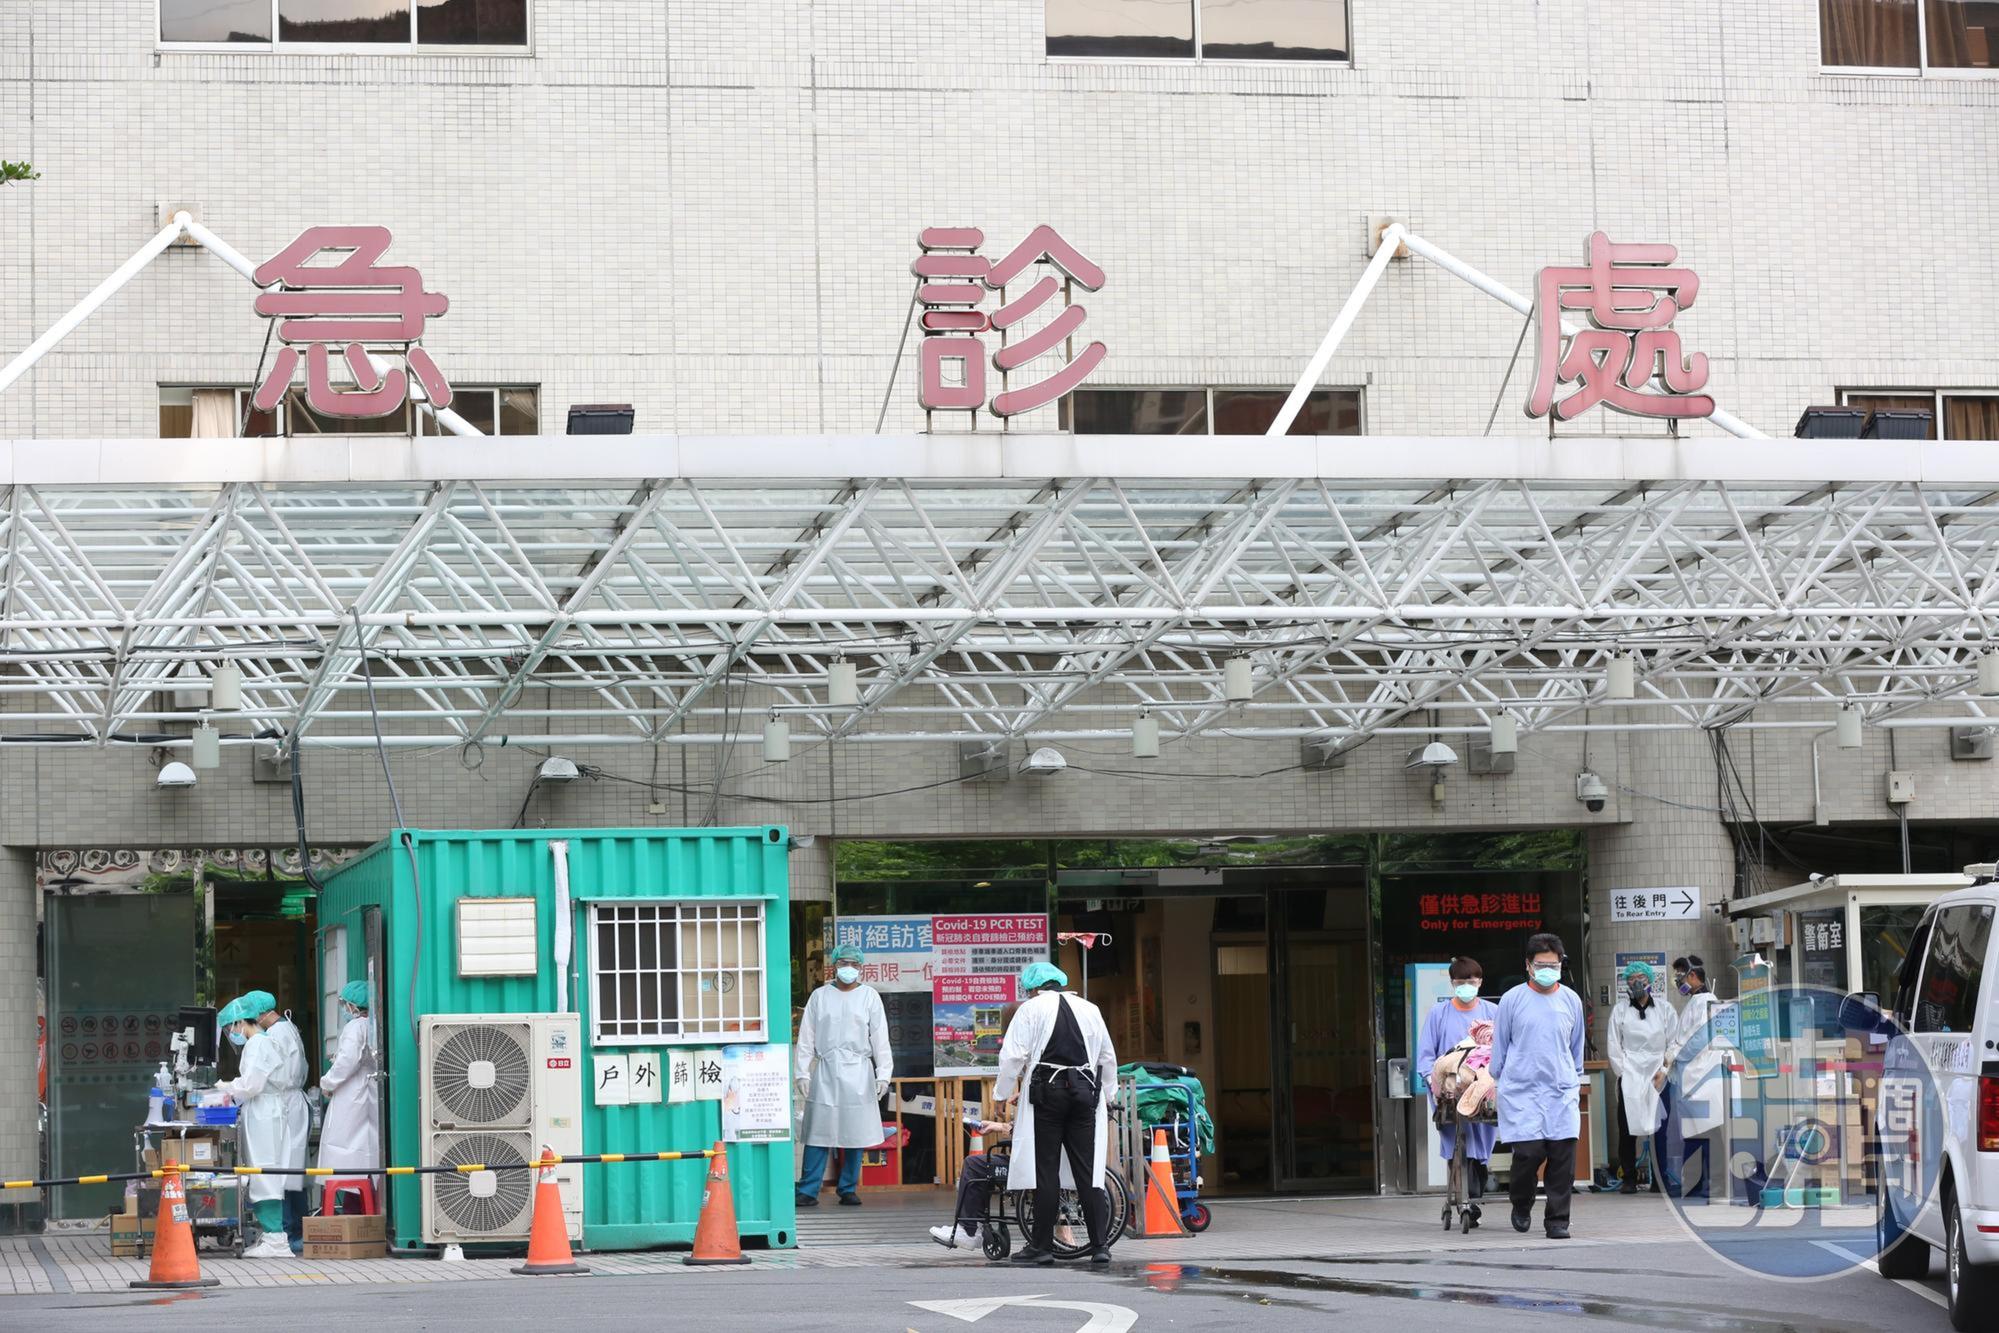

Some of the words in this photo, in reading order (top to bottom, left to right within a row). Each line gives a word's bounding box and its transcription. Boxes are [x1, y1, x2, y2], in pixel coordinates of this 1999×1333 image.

[252, 224, 1716, 421] 急診處
[1420, 893, 1541, 915] 僅供急診進出
[1615, 894, 1666, 909] 往後門
[936, 920, 987, 930] Covid-19
[990, 919, 1013, 930] PCR
[1016, 919, 1044, 929] TEST
[1421, 919, 1448, 931] Only
[1452, 919, 1469, 930] for
[1473, 918, 1542, 931] Emergency
[1646, 910, 1666, 919] Entry
[839, 925, 932, 948] 謝絕訪客
[1805, 921, 1843, 951] 警衛室
[600, 1060, 722, 1090] 戶外篩檢
